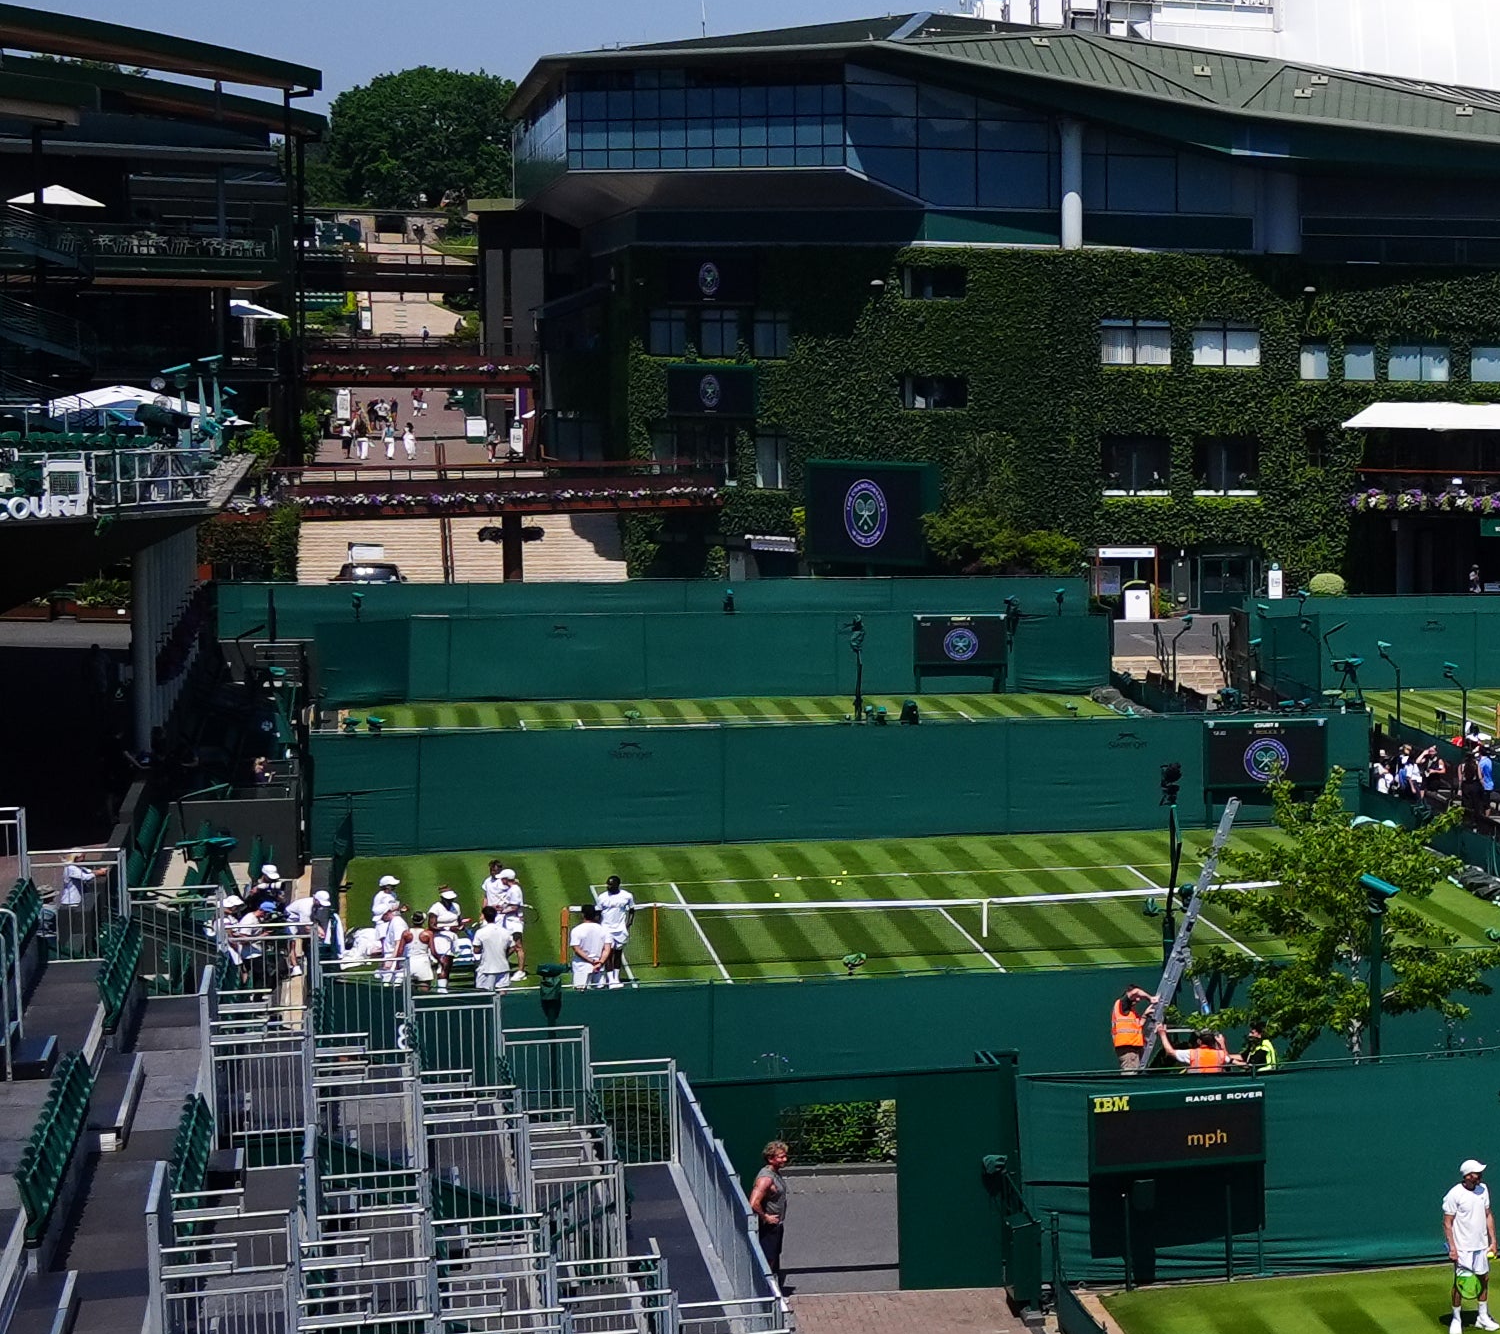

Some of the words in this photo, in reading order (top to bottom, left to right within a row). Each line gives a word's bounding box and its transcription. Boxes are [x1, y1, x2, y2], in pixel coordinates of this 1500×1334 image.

[1093, 1096, 1130, 1113] IBM
[1185, 1094, 1222, 1103] RANGE
[1227, 1091, 1263, 1100] ROVER
[1187, 1129, 1228, 1148] mph
